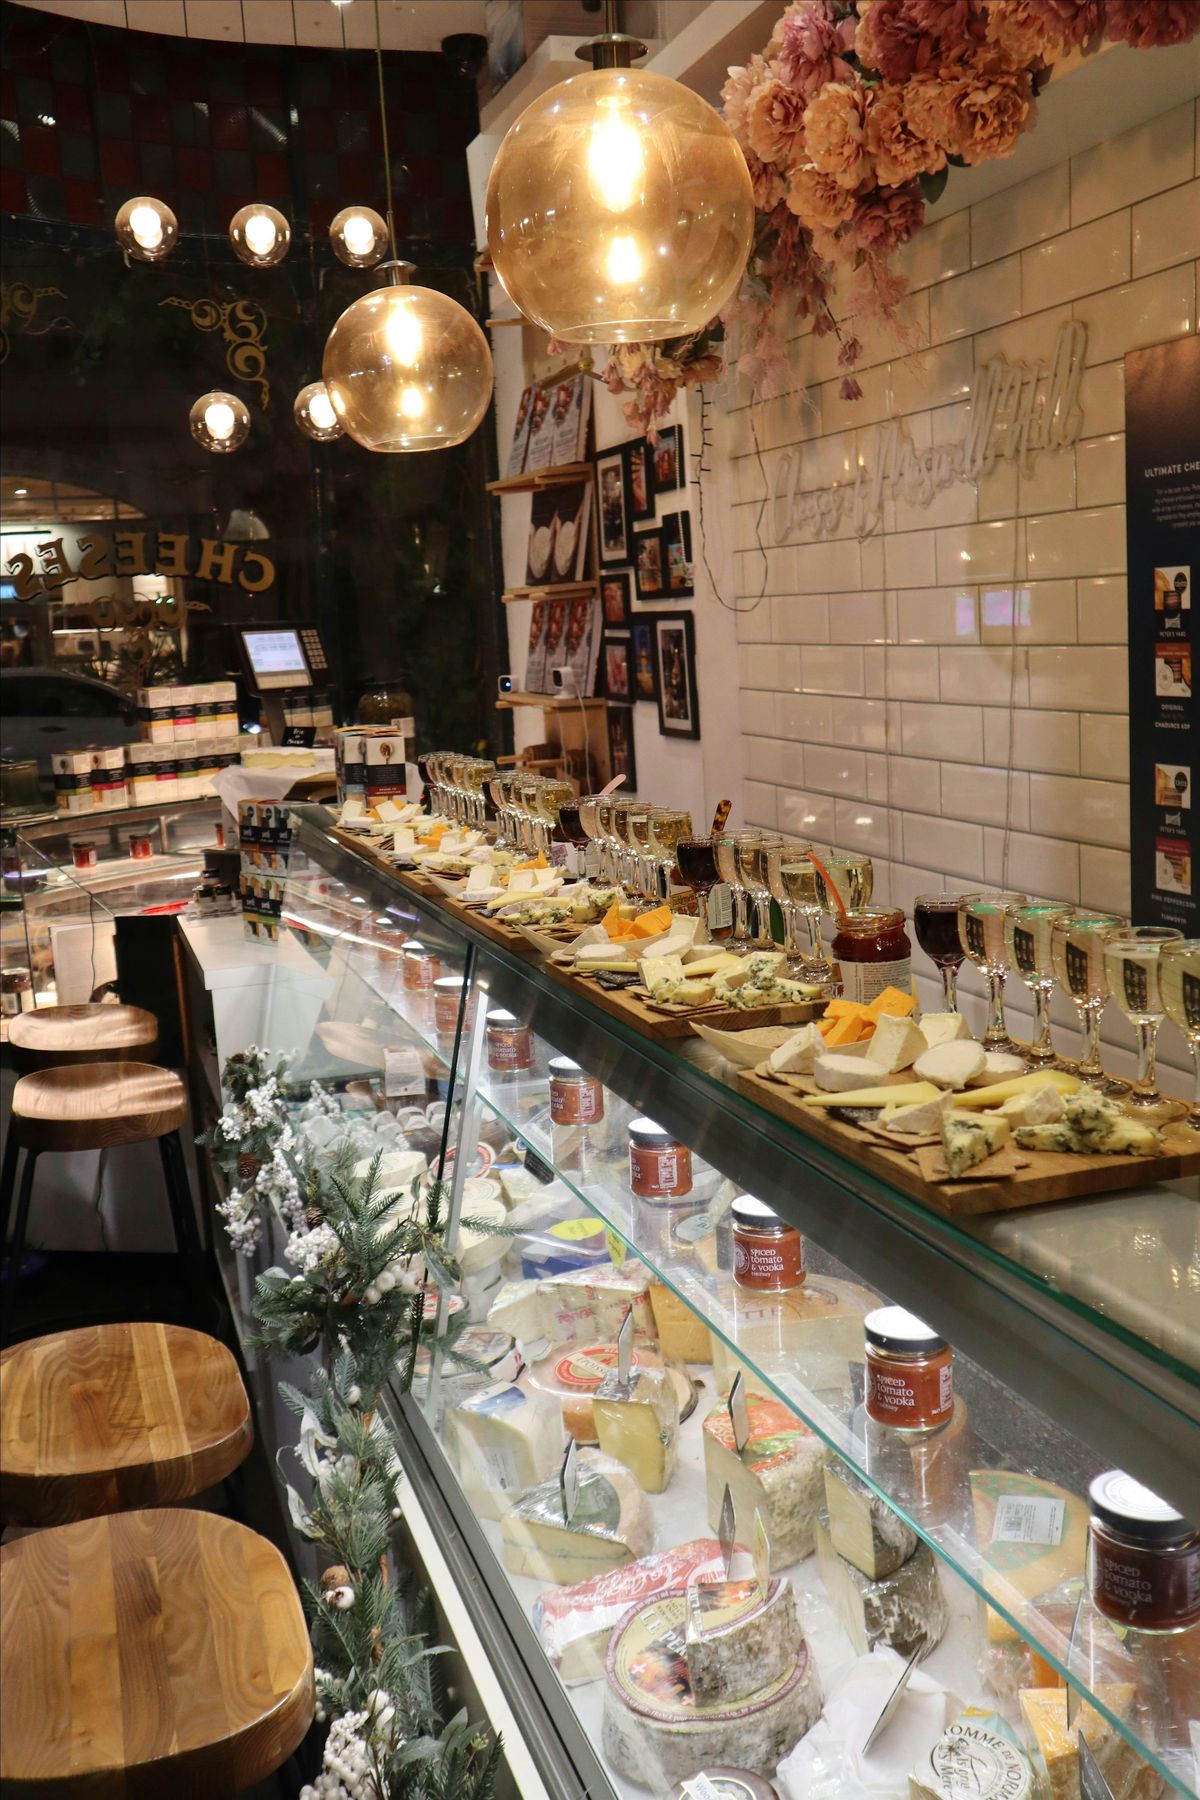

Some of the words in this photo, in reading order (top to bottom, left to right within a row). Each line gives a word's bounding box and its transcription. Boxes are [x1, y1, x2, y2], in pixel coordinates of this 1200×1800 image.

[1144, 463, 1182, 478] ULTIMATE
[750, 1256, 783, 1264] tomato
[877, 1382, 914, 1397] tomato
[1104, 1568, 1152, 1591] tomato
[1001, 1750, 1015, 1761] DE
